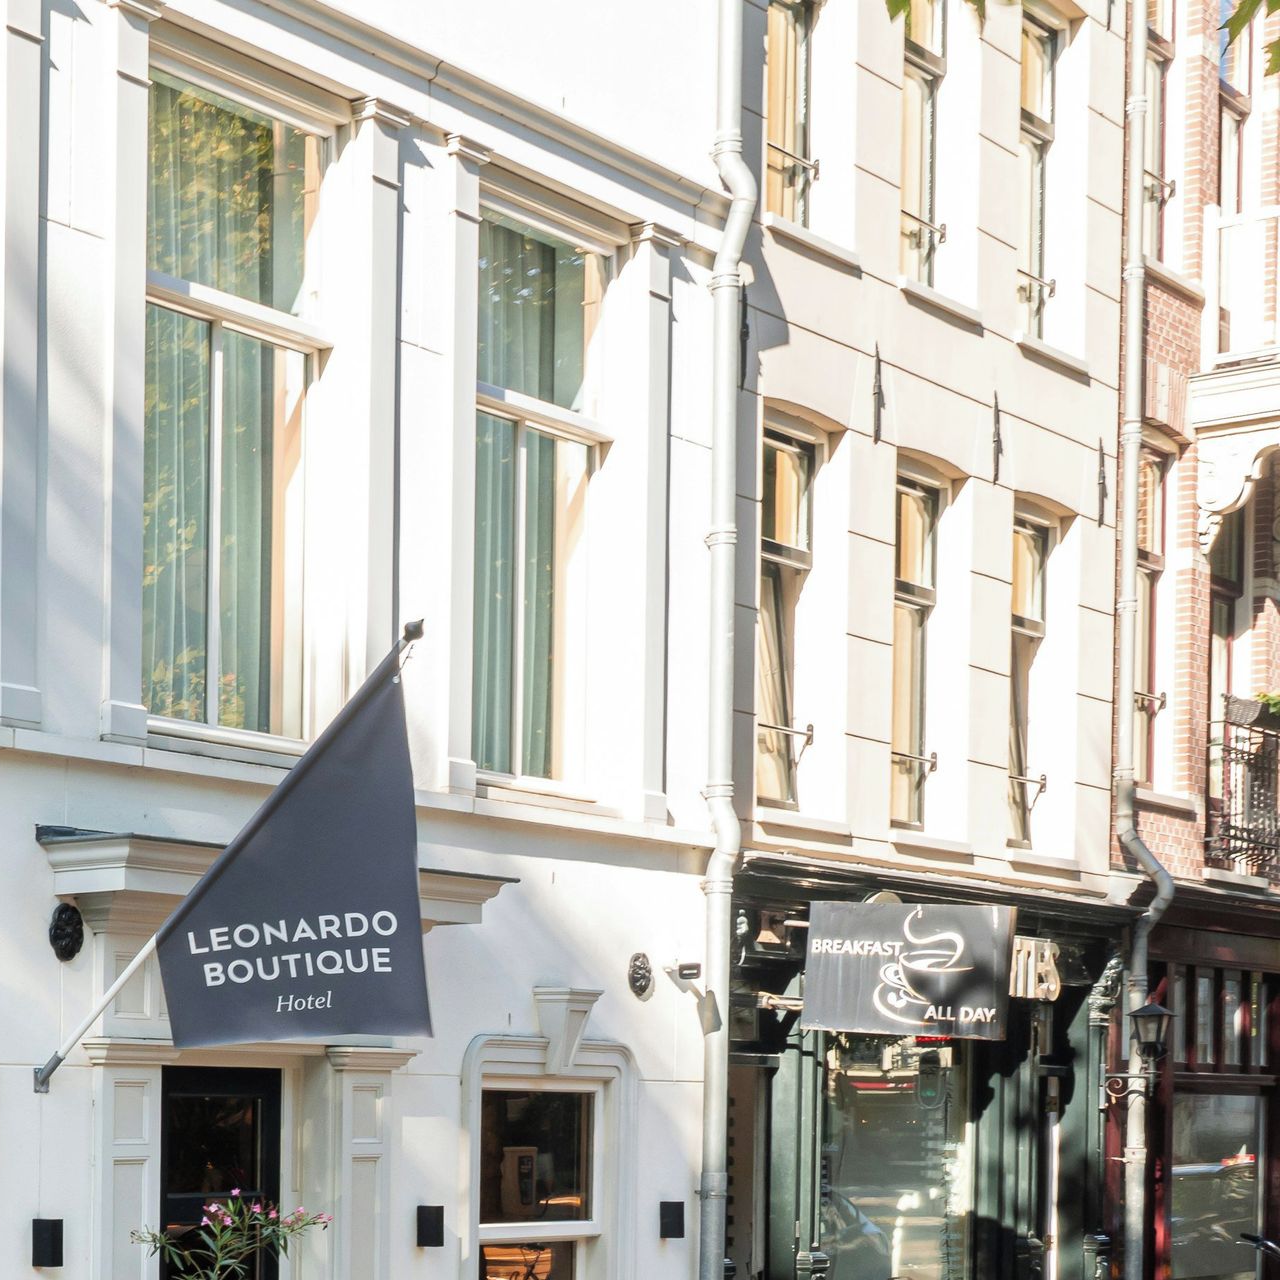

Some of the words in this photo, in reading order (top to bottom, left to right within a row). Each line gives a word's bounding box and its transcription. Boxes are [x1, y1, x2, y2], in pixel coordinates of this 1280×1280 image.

[187, 910, 398, 955] LEONARDO
[811, 938, 904, 957] BREAKFAST
[203, 947, 392, 987] BOUTIQUE
[276, 990, 333, 1013] Hotel
[924, 1004, 956, 1021] ALL
